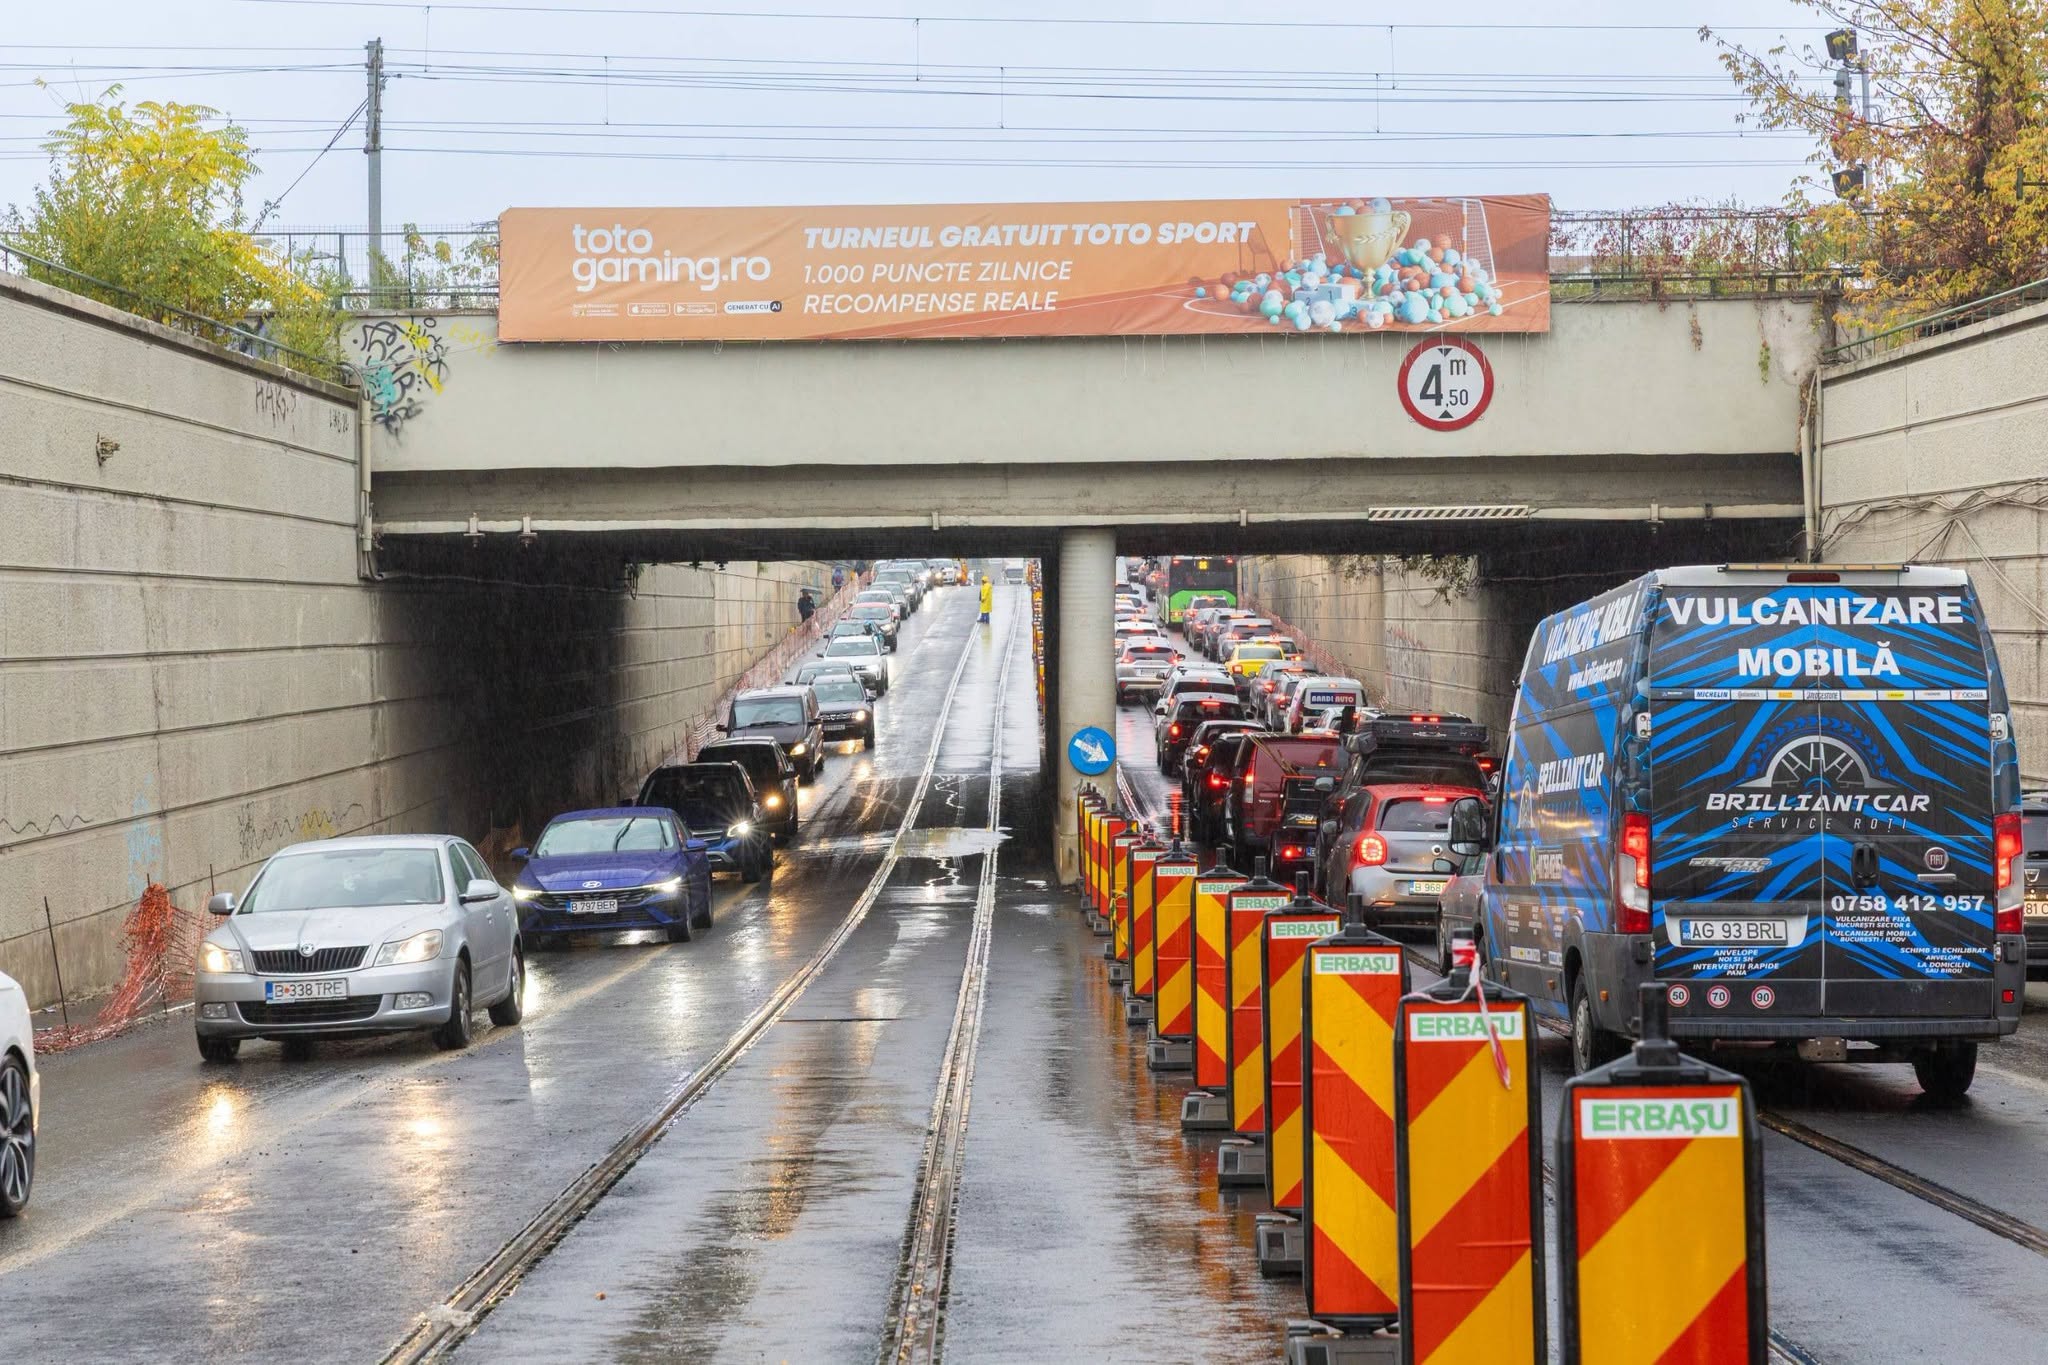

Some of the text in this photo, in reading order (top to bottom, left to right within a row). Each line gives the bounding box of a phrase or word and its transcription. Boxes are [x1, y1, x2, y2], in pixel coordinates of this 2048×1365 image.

[573, 224, 653, 254] toto
[805, 221, 1256, 249] TURNEUL GRATUIT TOTO SPORT
[573, 250, 771, 292] gaming.ro
[804, 260, 1073, 284] 1.000 PUNCTE ZILNICE
[771, 301, 781, 310] AI
[803, 291, 1058, 314] RECOMPENSE REALE
[1666, 596, 1964, 625] VULCANIZARE
[1542, 605, 1606, 666] VULCANIZARE
[1738, 640, 1901, 677] MOBILĂ
[1335, 694, 1354, 704] AUTO
[1696, 690, 1728, 698] MICHELIN
[1538, 752, 1604, 795] BRILLIANT CAR
[1706, 793, 1930, 812] BRILLIANT CAR
[1732, 816, 1832, 830] SERVICE
[1930, 854, 1943, 865] FIAT
[1424, 883, 1440, 892] 968
[572, 903, 578, 911] B
[580, 902, 595, 911] 797
[1831, 895, 1985, 911] 0758 412 957
[1692, 922, 1783, 940] AG 93 BRL
[275, 981, 343, 998] B 338 TRE
[1672, 991, 1685, 1001] 50
[1712, 992, 1726, 1002] 70
[1756, 992, 1770, 1002] 90
